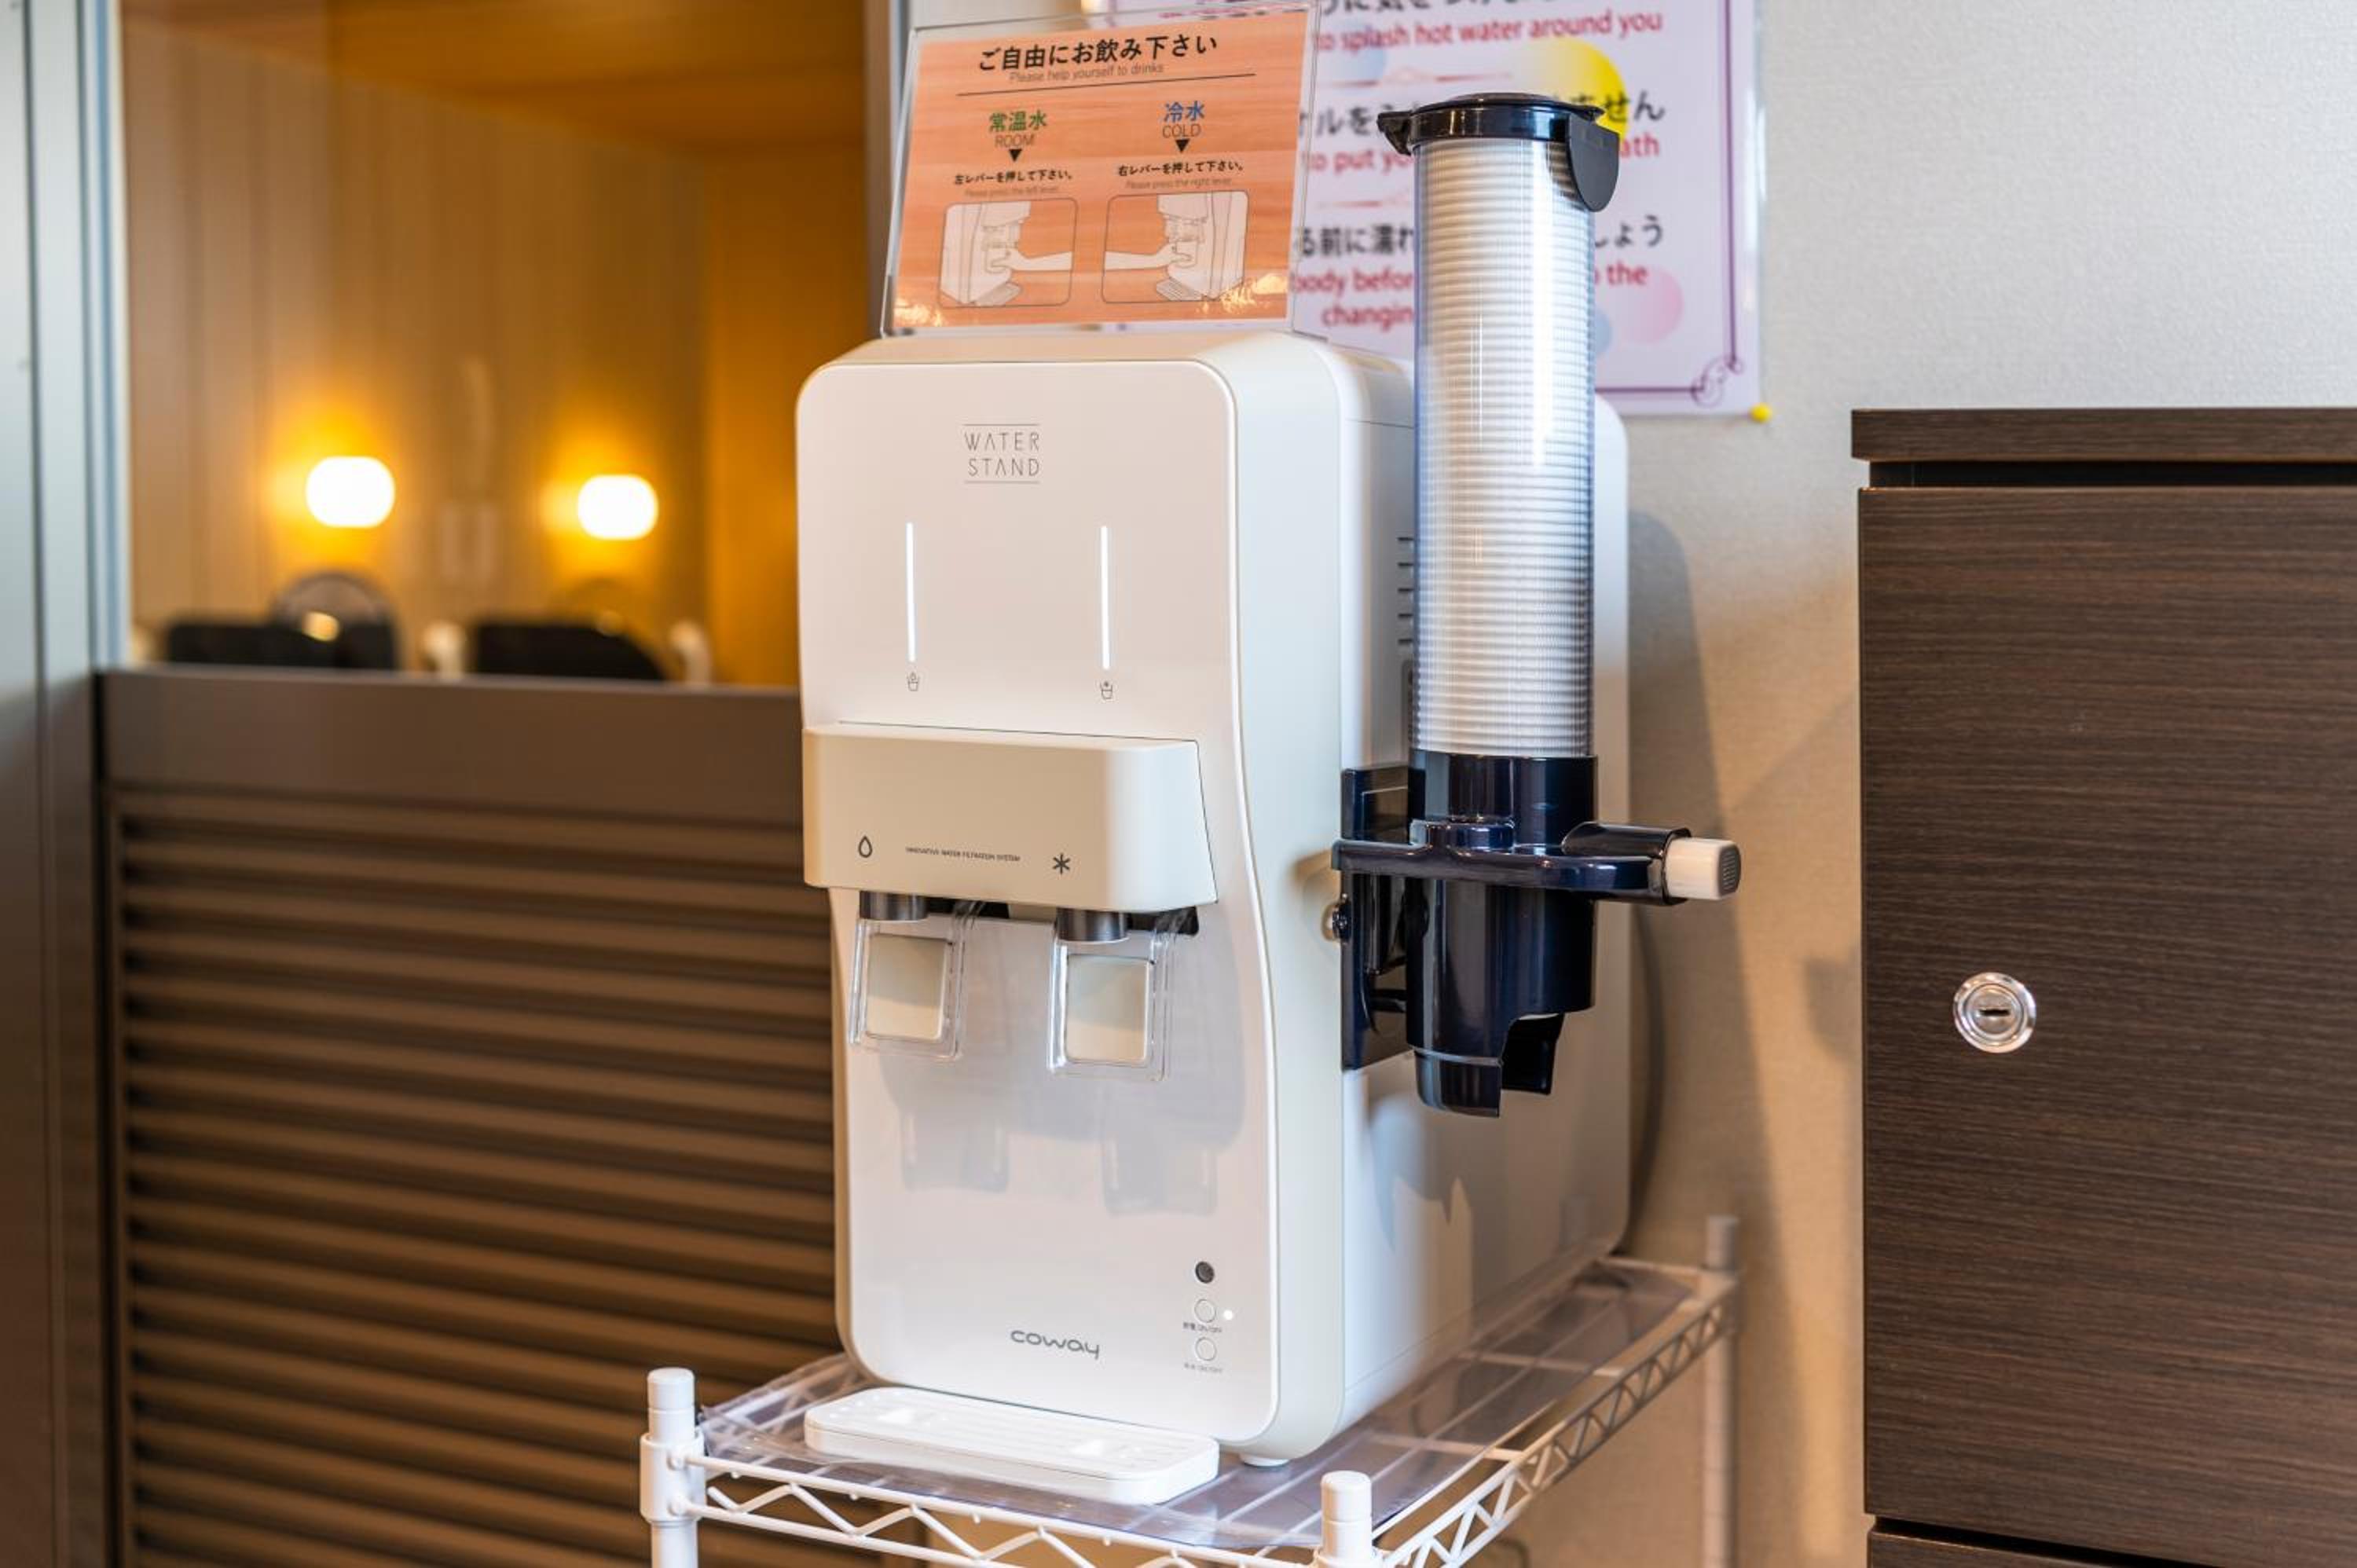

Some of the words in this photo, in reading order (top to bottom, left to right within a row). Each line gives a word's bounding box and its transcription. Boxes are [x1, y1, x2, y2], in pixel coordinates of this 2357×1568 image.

[1341, 24, 1409, 54] splash
[1415, 22, 1453, 44] hot
[1457, 20, 1523, 42] water
[1530, 9, 1611, 38] around
[1618, 12, 1663, 40] you
[980, 34, 1218, 71] ご自由にお飲み下さい
[1010, 71, 1044, 82] Please
[1047, 69, 1071, 82] help
[1072, 63, 1115, 81] yourself
[1117, 62, 1128, 75] to
[1131, 61, 1164, 75] drinks
[989, 110, 1047, 132] 常温水
[1164, 101, 1205, 123] 冷水
[994, 134, 1035, 148] ROOM
[1162, 123, 1202, 139] COLD
[1333, 150, 1374, 175] put
[1620, 132, 1659, 159] ath
[1352, 268, 1414, 291] befor
[1607, 262, 1648, 285] the
[1321, 305, 1414, 332] changin
[964, 432, 1040, 452] WATER
[967, 457, 1040, 477] STAND
[1010, 1330, 1100, 1361] coway
